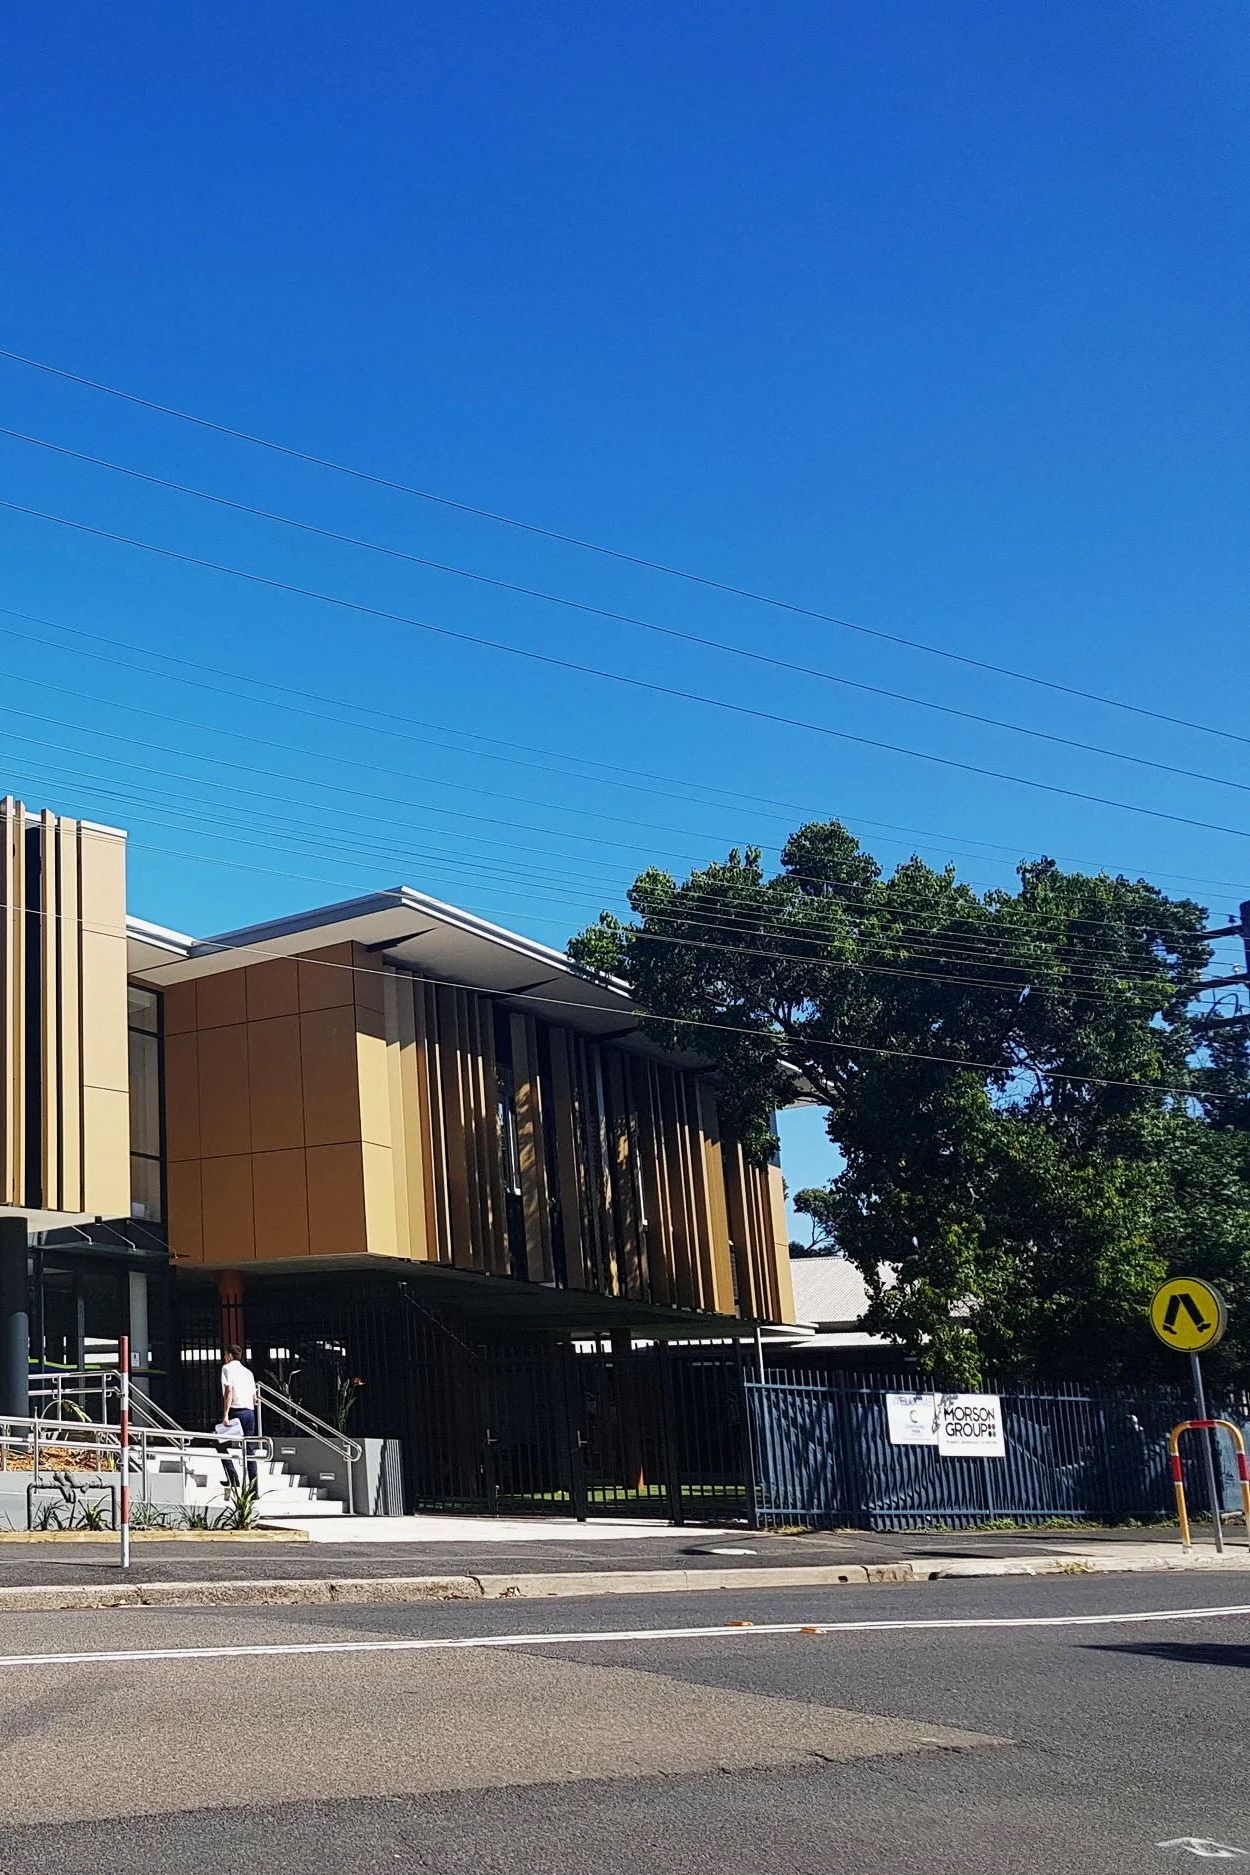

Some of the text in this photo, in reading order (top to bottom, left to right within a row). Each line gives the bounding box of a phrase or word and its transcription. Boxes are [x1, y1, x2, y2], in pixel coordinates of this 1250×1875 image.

[893, 1396, 933, 1407] WELCOME
[943, 1406, 996, 1421] MORSON
[945, 1422, 988, 1437] GROUP
